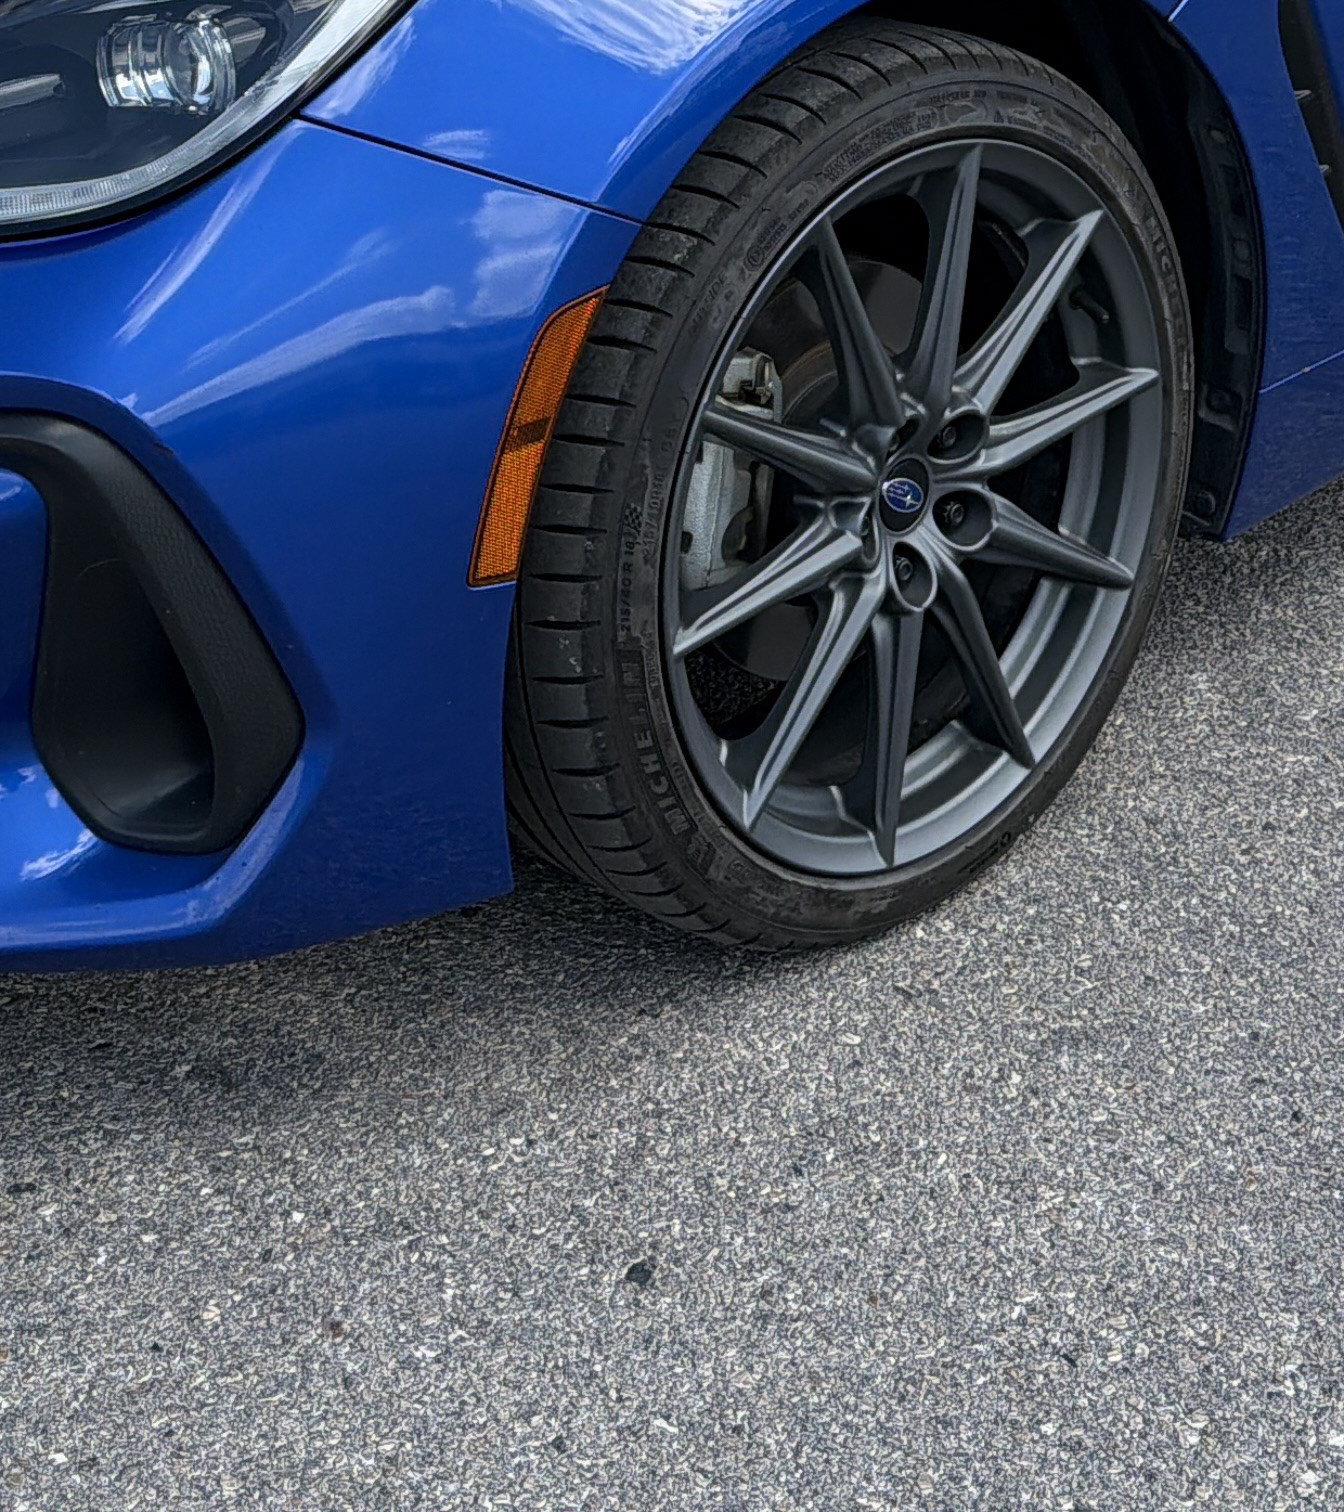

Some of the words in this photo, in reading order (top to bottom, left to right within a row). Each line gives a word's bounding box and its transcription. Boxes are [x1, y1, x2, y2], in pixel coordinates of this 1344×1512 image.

[623, 541, 636, 556] 18
[623, 562, 634, 573] R
[620, 576, 634, 633] 215/40
[621, 661, 691, 836] MICHELIN
